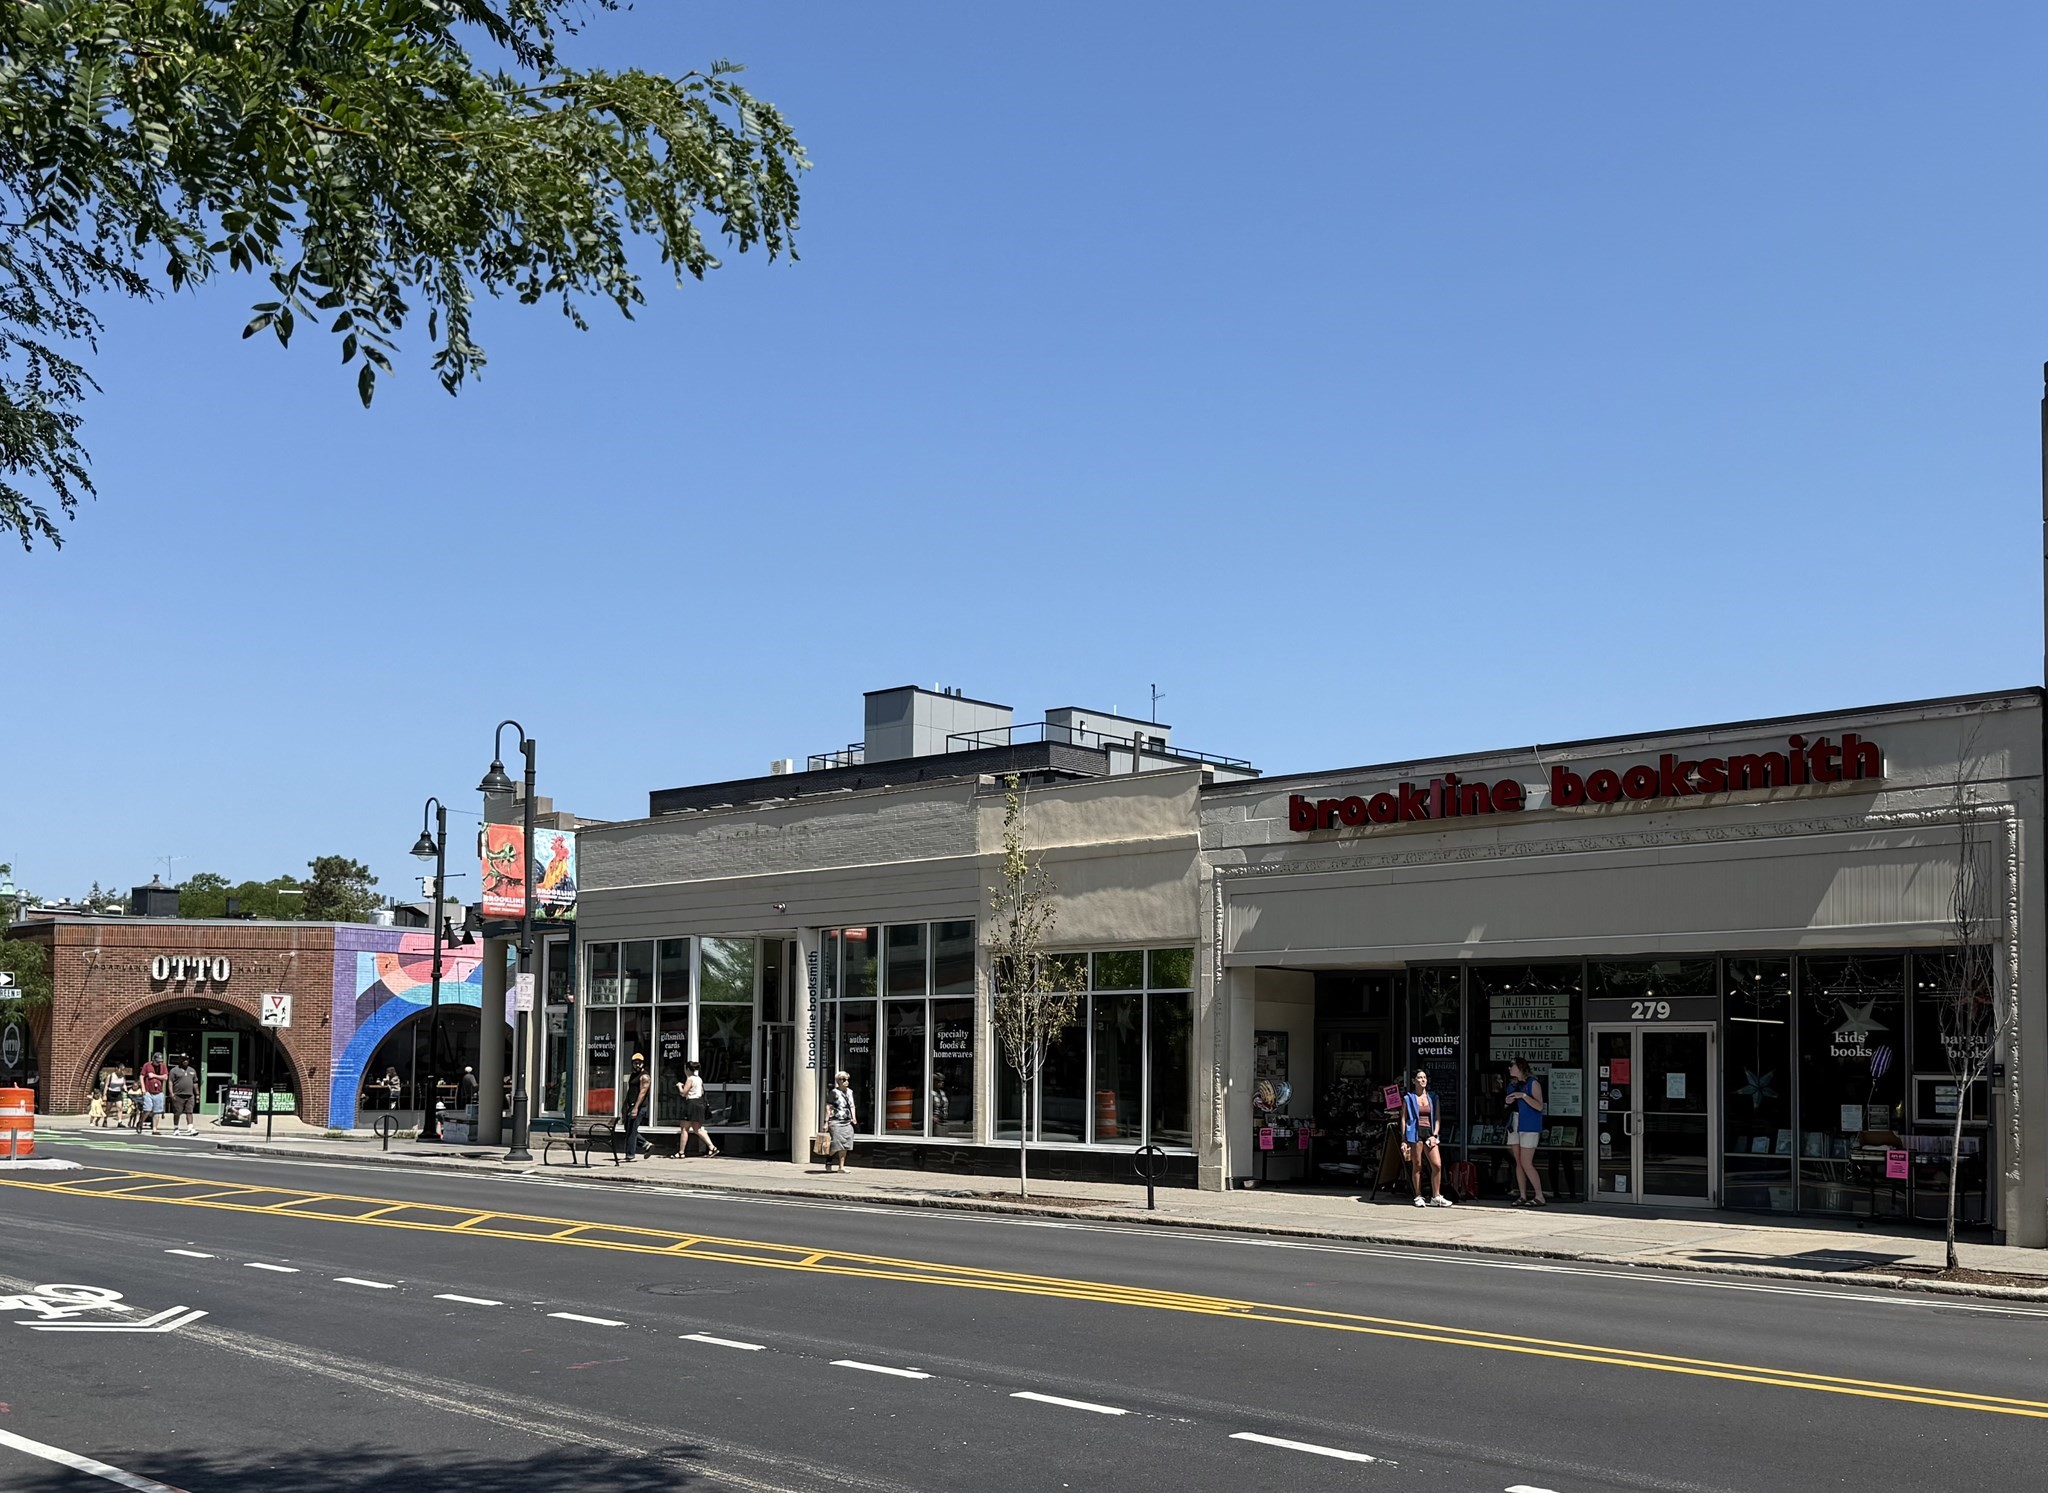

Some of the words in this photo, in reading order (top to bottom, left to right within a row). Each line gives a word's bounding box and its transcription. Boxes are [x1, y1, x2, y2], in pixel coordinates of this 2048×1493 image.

[1289, 772, 1526, 832] brookline
[1552, 733, 1883, 807] booksmith
[536, 887, 576, 897] BROOKLINE
[483, 895, 525, 905] BROOKLINE
[152, 955, 231, 982] OTTO
[807, 950, 818, 1012] booksmith
[1502, 996, 1555, 1006] INJUSTICE
[1501, 1009, 1556, 1019] ANYWHERE
[1631, 1002, 1671, 1020] 279
[605, 1033, 610, 1041] &
[660, 1032, 685, 1042] giftsmith
[849, 1035, 870, 1044] author
[937, 1029, 969, 1040] specialty
[1411, 1033, 1460, 1045] upcoming
[1940, 1032, 1988, 1047] bargai
[587, 1041, 616, 1050] noteworthy
[665, 1041, 680, 1049] cards
[806, 1013, 816, 1069] brookline
[940, 1040, 959, 1050] foods
[960, 1040, 966, 1050] &
[1508, 1038, 1551, 1048] JUSTICE
[669, 1050, 681, 1059] gifts
[849, 1045, 869, 1054] events
[933, 1048, 973, 1058] homewares
[1418, 1045, 1453, 1055] events
[1830, 1045, 1873, 1057] books
[1495, 1050, 1564, 1060] EVERYWHERE
